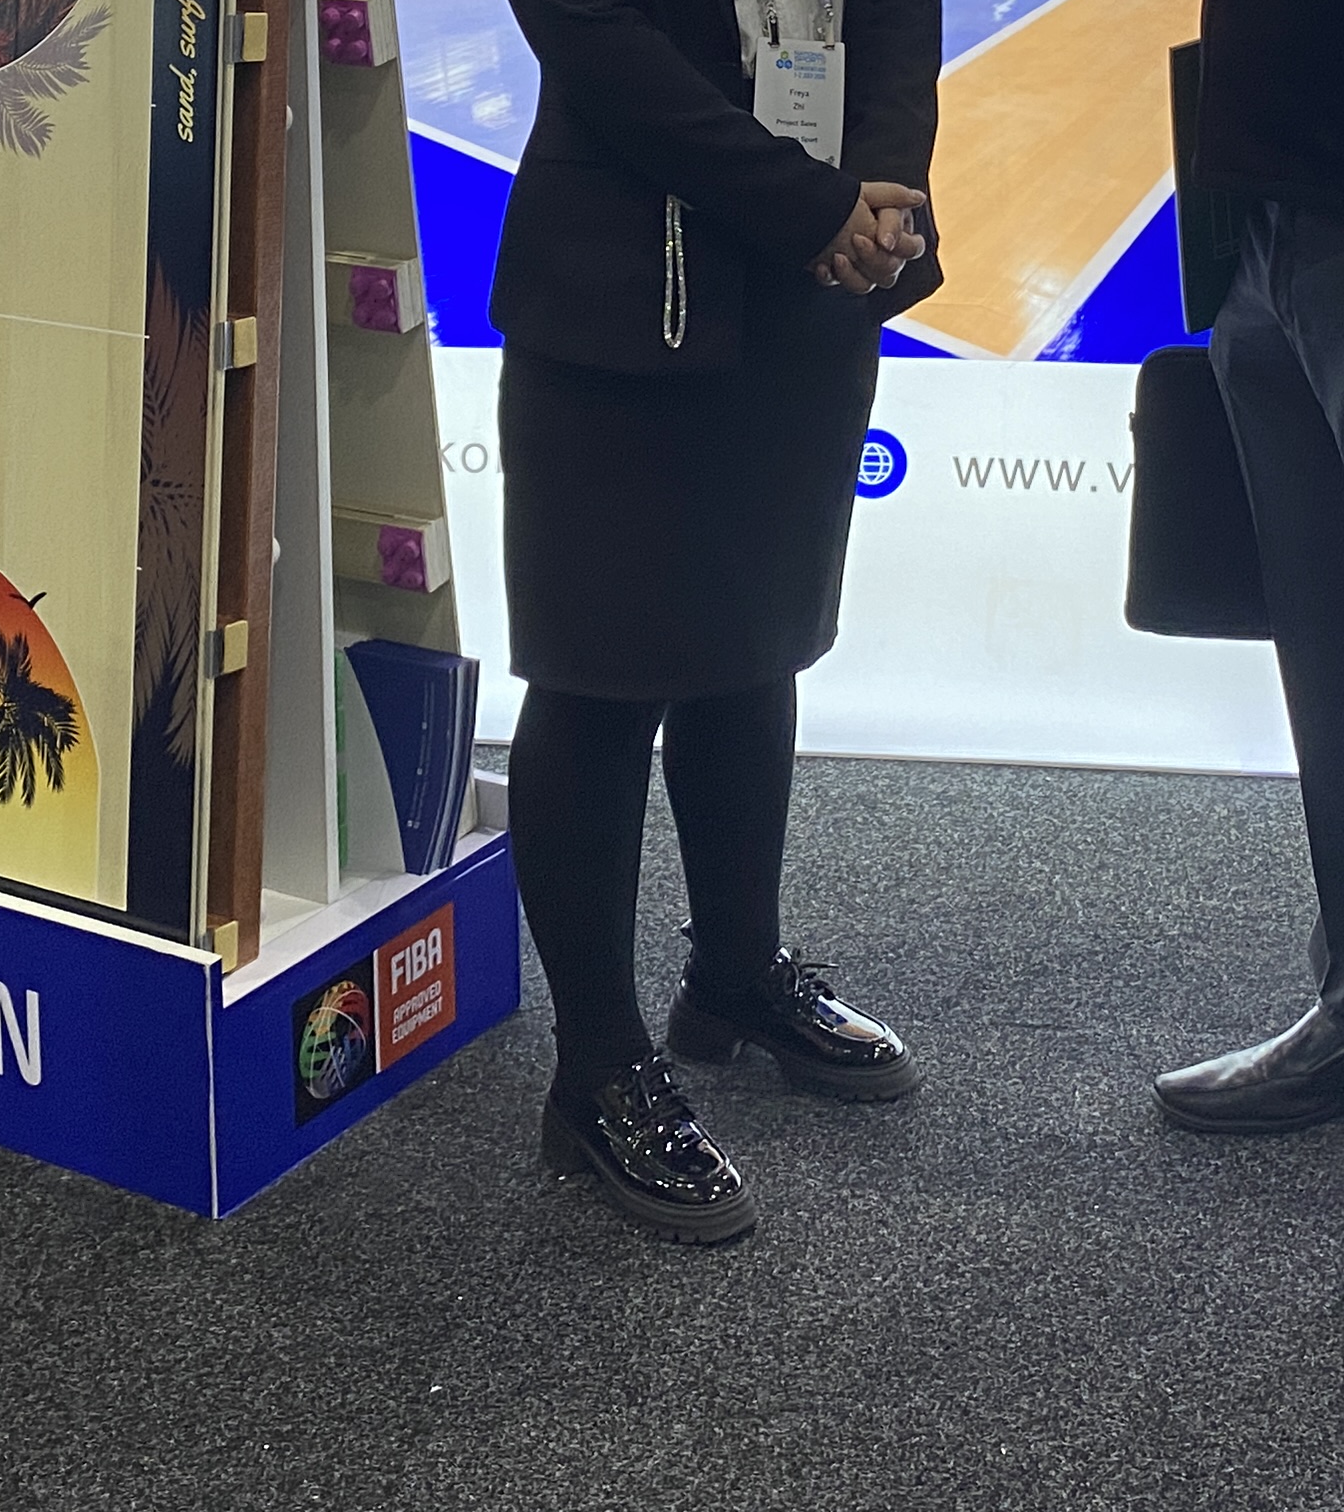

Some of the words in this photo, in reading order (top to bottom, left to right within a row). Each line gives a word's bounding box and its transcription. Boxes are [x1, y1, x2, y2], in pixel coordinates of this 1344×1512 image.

[391, 927, 443, 995] FIBA
[392, 996, 443, 1045] EQUIPMENT
[393, 980, 442, 1025] APPROVED
